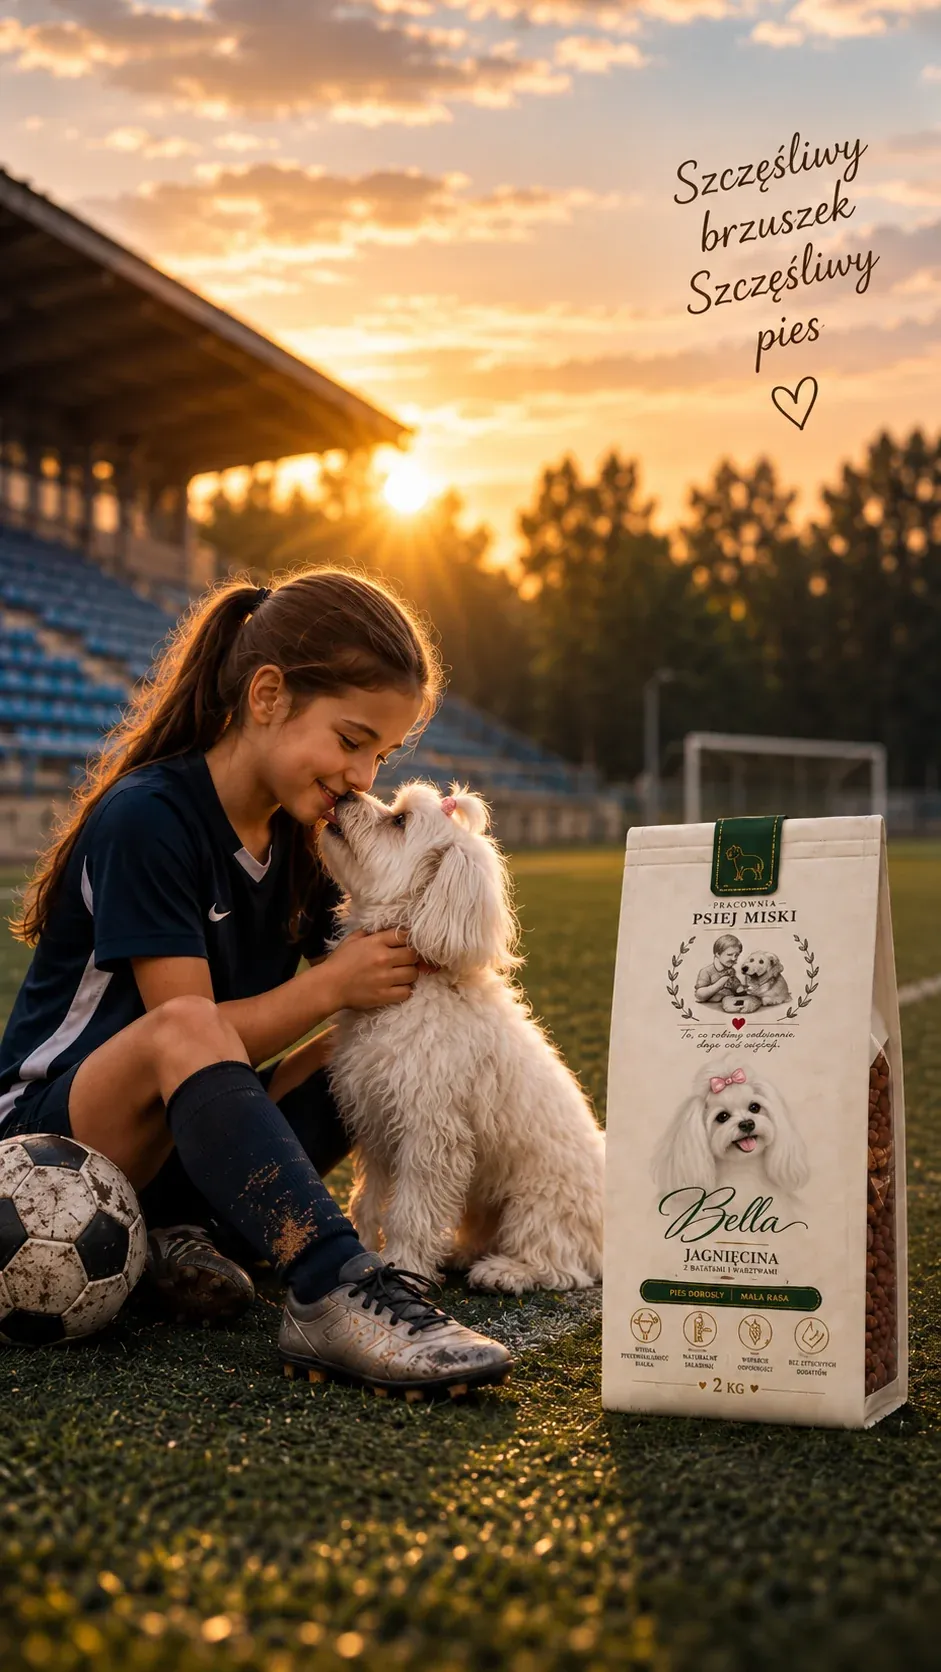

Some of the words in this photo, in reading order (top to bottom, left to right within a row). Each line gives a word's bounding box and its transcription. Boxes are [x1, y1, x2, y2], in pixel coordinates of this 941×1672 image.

[713, 900, 777, 909] PRACOWNIA
[692, 912, 737, 927] PSIEJ
[744, 910, 797, 924] MISKI
[658, 1186, 808, 1243] Bella
[684, 1248, 779, 1266] JAGNIĘCINA
[669, 1288, 687, 1298] PIES
[767, 1294, 789, 1302] RASA
[713, 1378, 722, 1393] 2
[727, 1382, 745, 1395] KG
